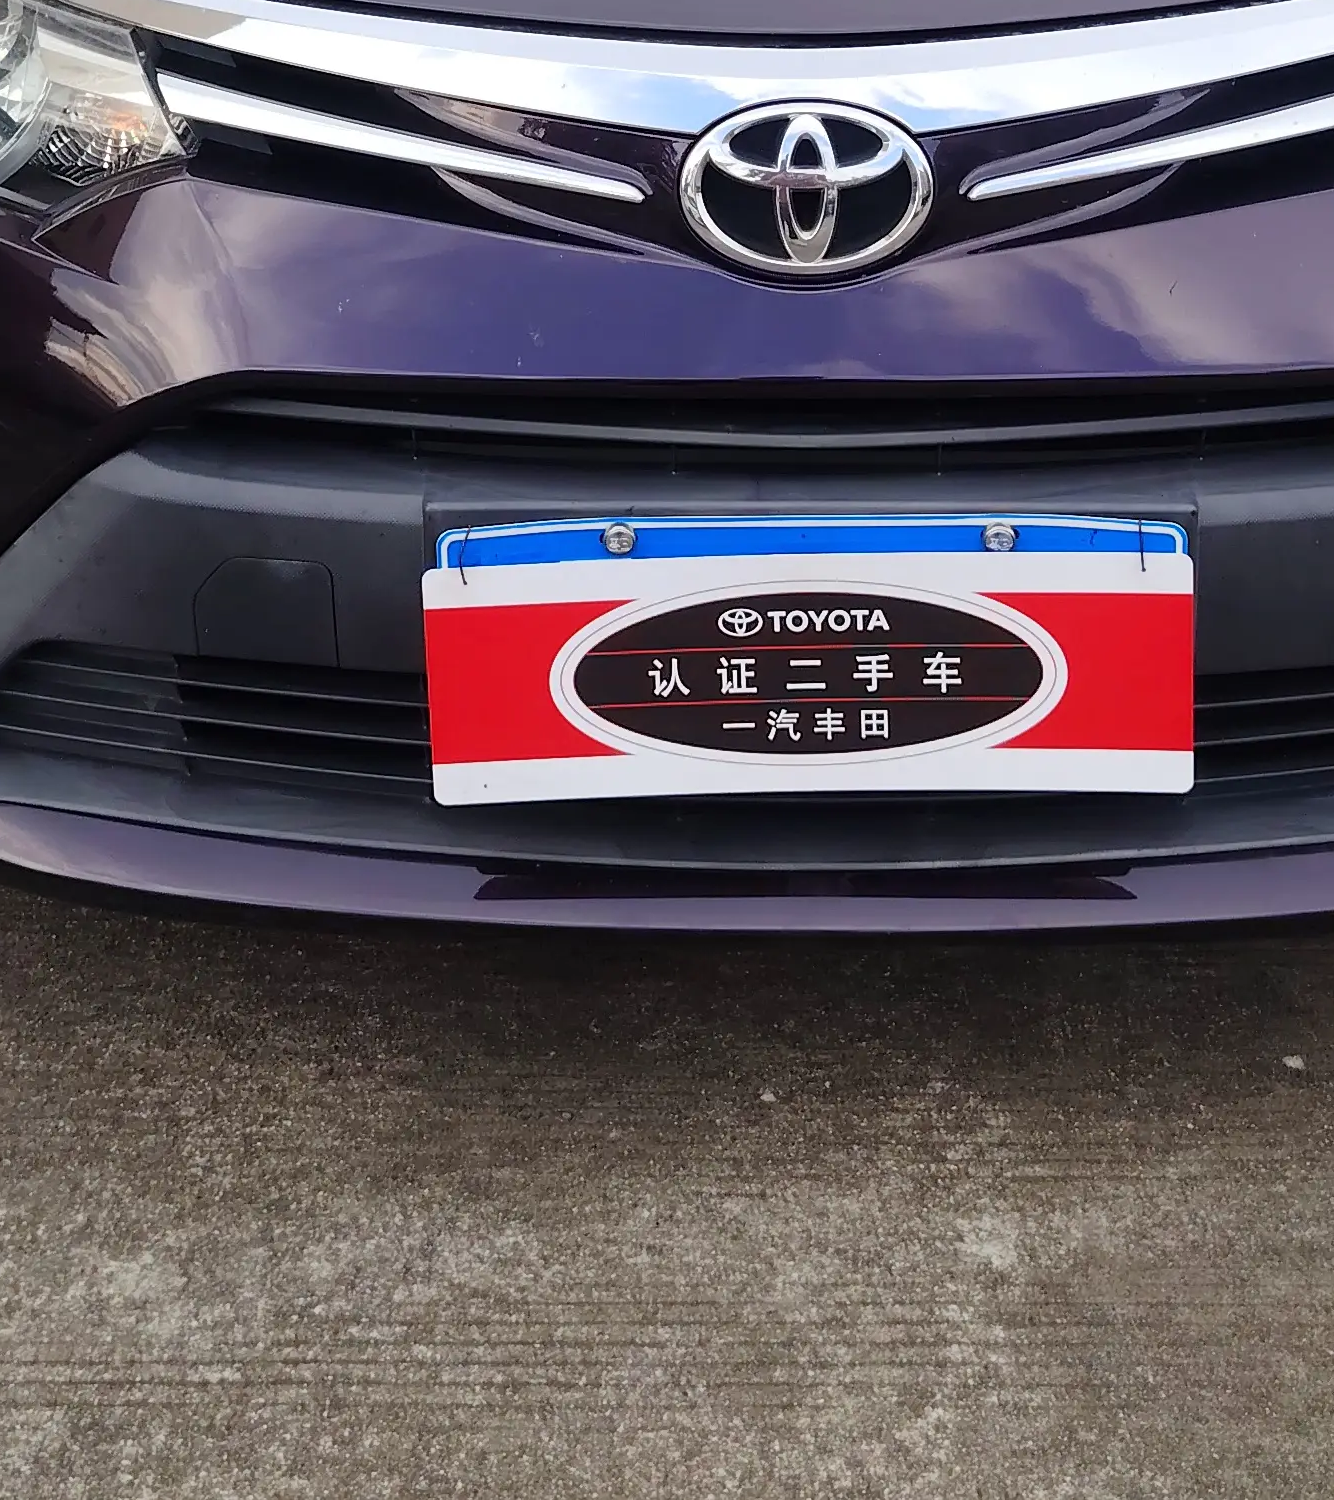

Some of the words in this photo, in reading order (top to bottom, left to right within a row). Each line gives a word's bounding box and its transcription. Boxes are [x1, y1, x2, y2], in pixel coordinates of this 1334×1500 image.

[767, 608, 890, 634] TOYOTA
[647, 650, 964, 699] 认证二手车
[722, 707, 890, 742] 一汽丰田
